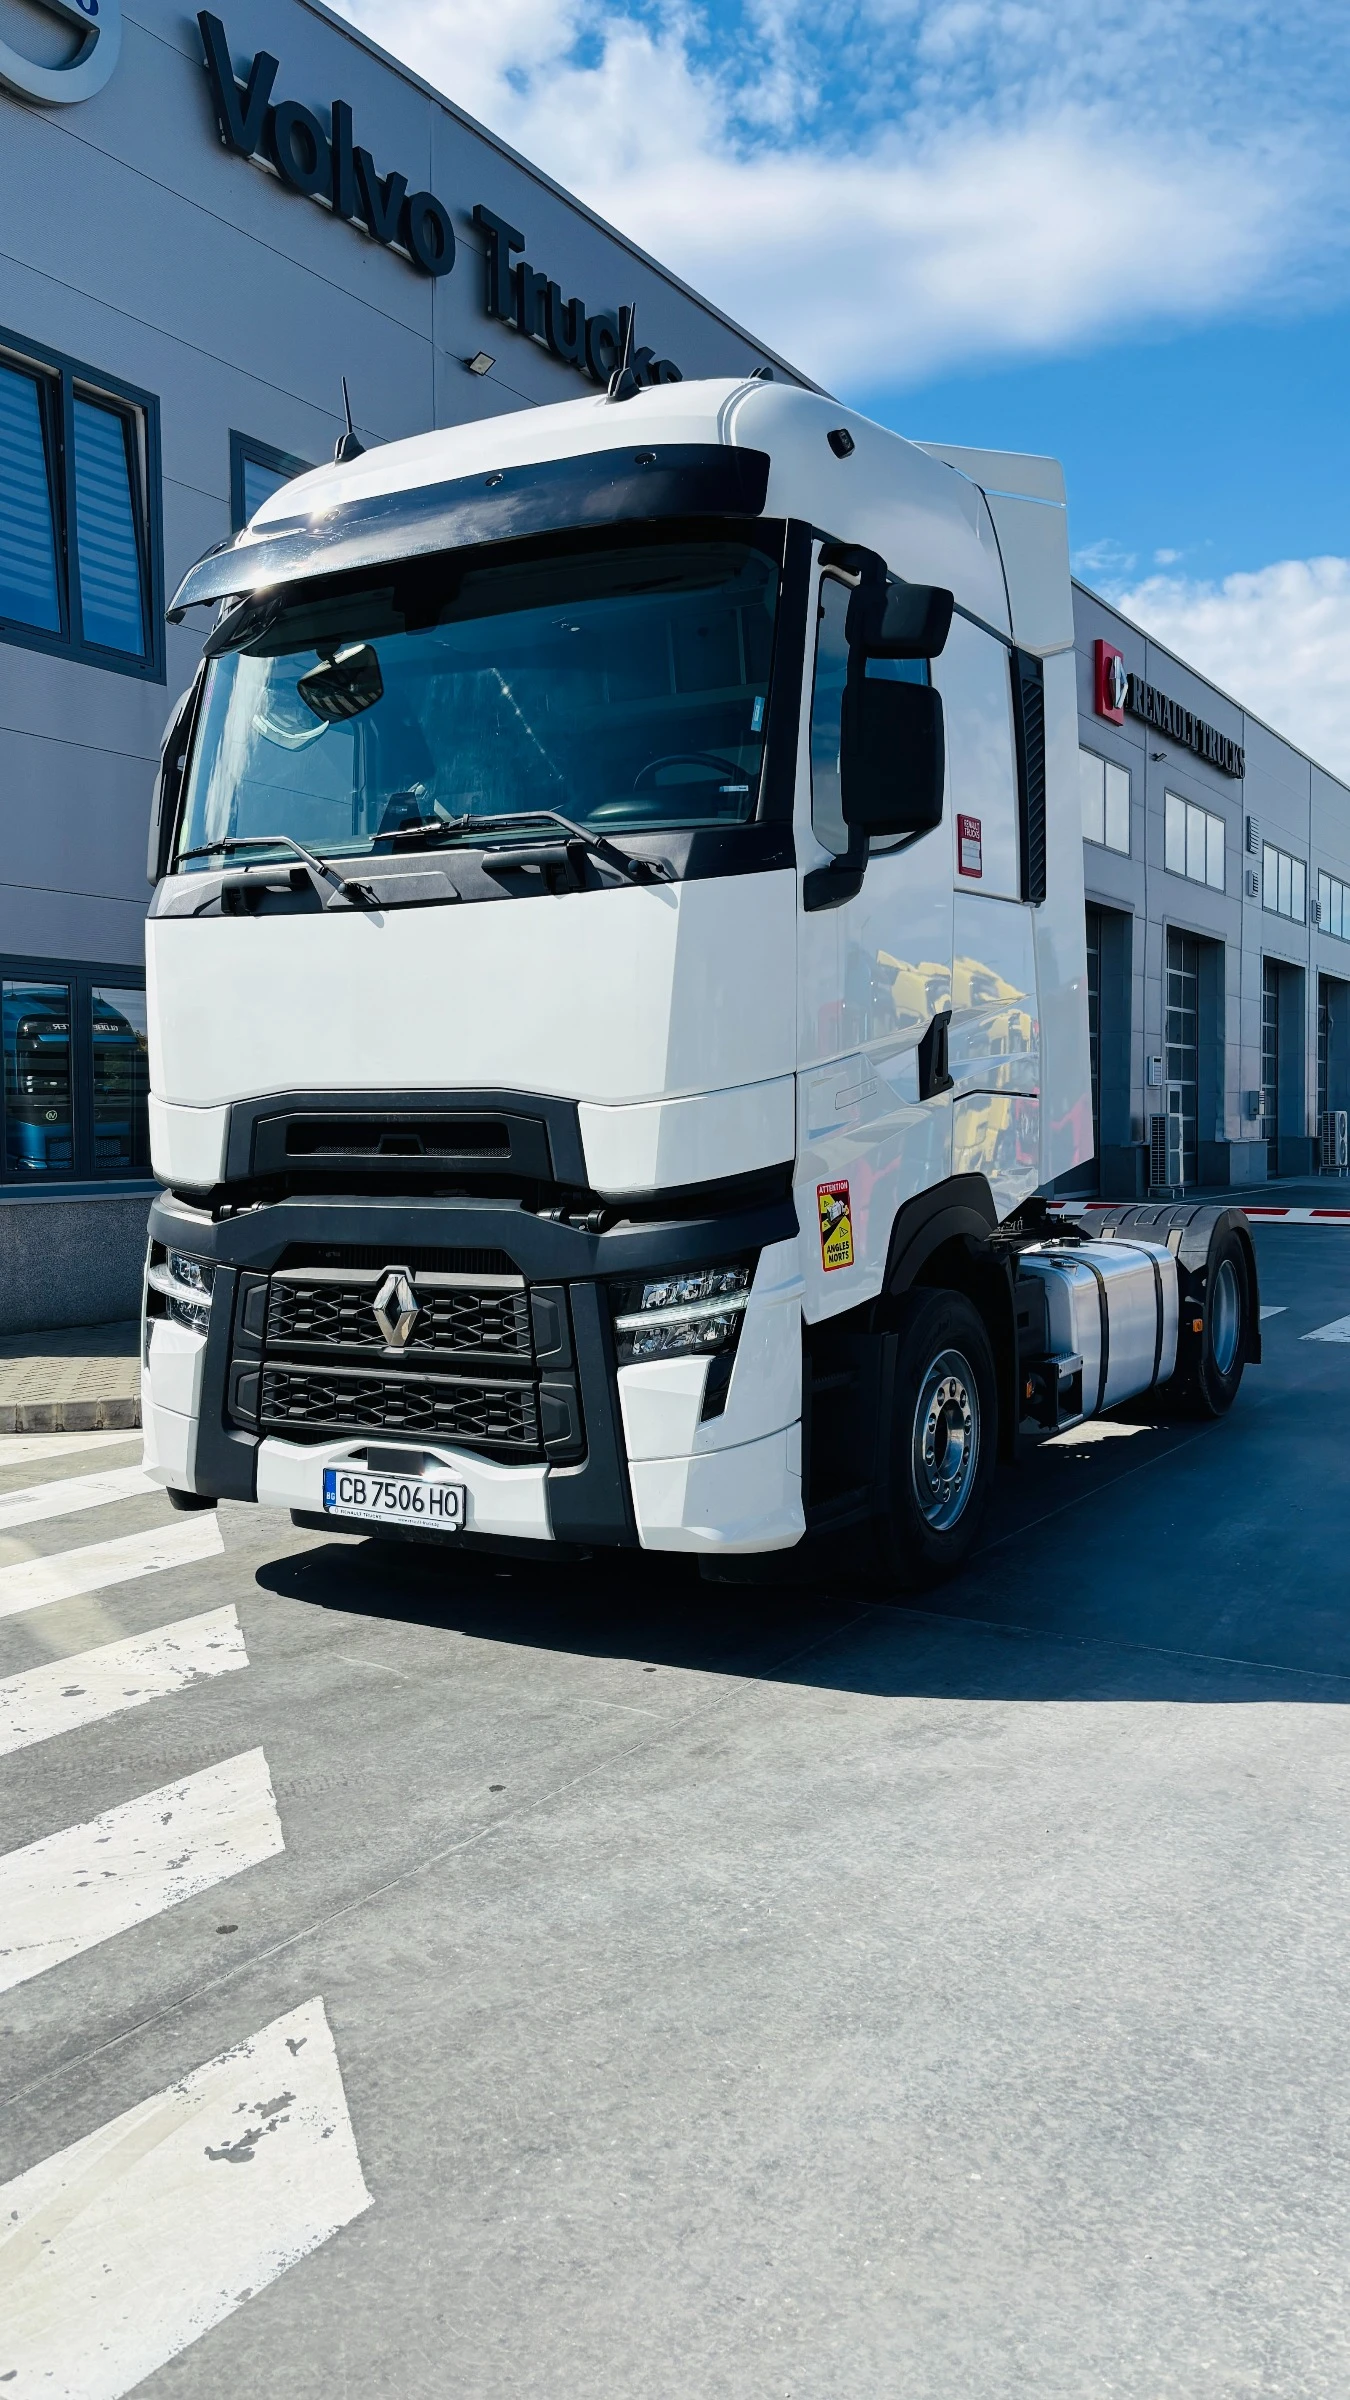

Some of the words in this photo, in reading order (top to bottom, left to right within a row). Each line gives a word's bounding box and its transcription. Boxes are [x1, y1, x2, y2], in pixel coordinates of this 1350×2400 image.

[197, 9, 456, 278] Volvo
[1126, 673, 1198, 750] RENAULT
[1197, 720, 1245, 779] TRUCKS
[818, 1182, 848, 1193] ATTENTION
[827, 1241, 850, 1254] ANGLES
[828, 1251, 849, 1263] MORTS
[326, 1492, 336, 1500] BG
[339, 1477, 367, 1504] CB
[371, 1481, 425, 1512] 7506
